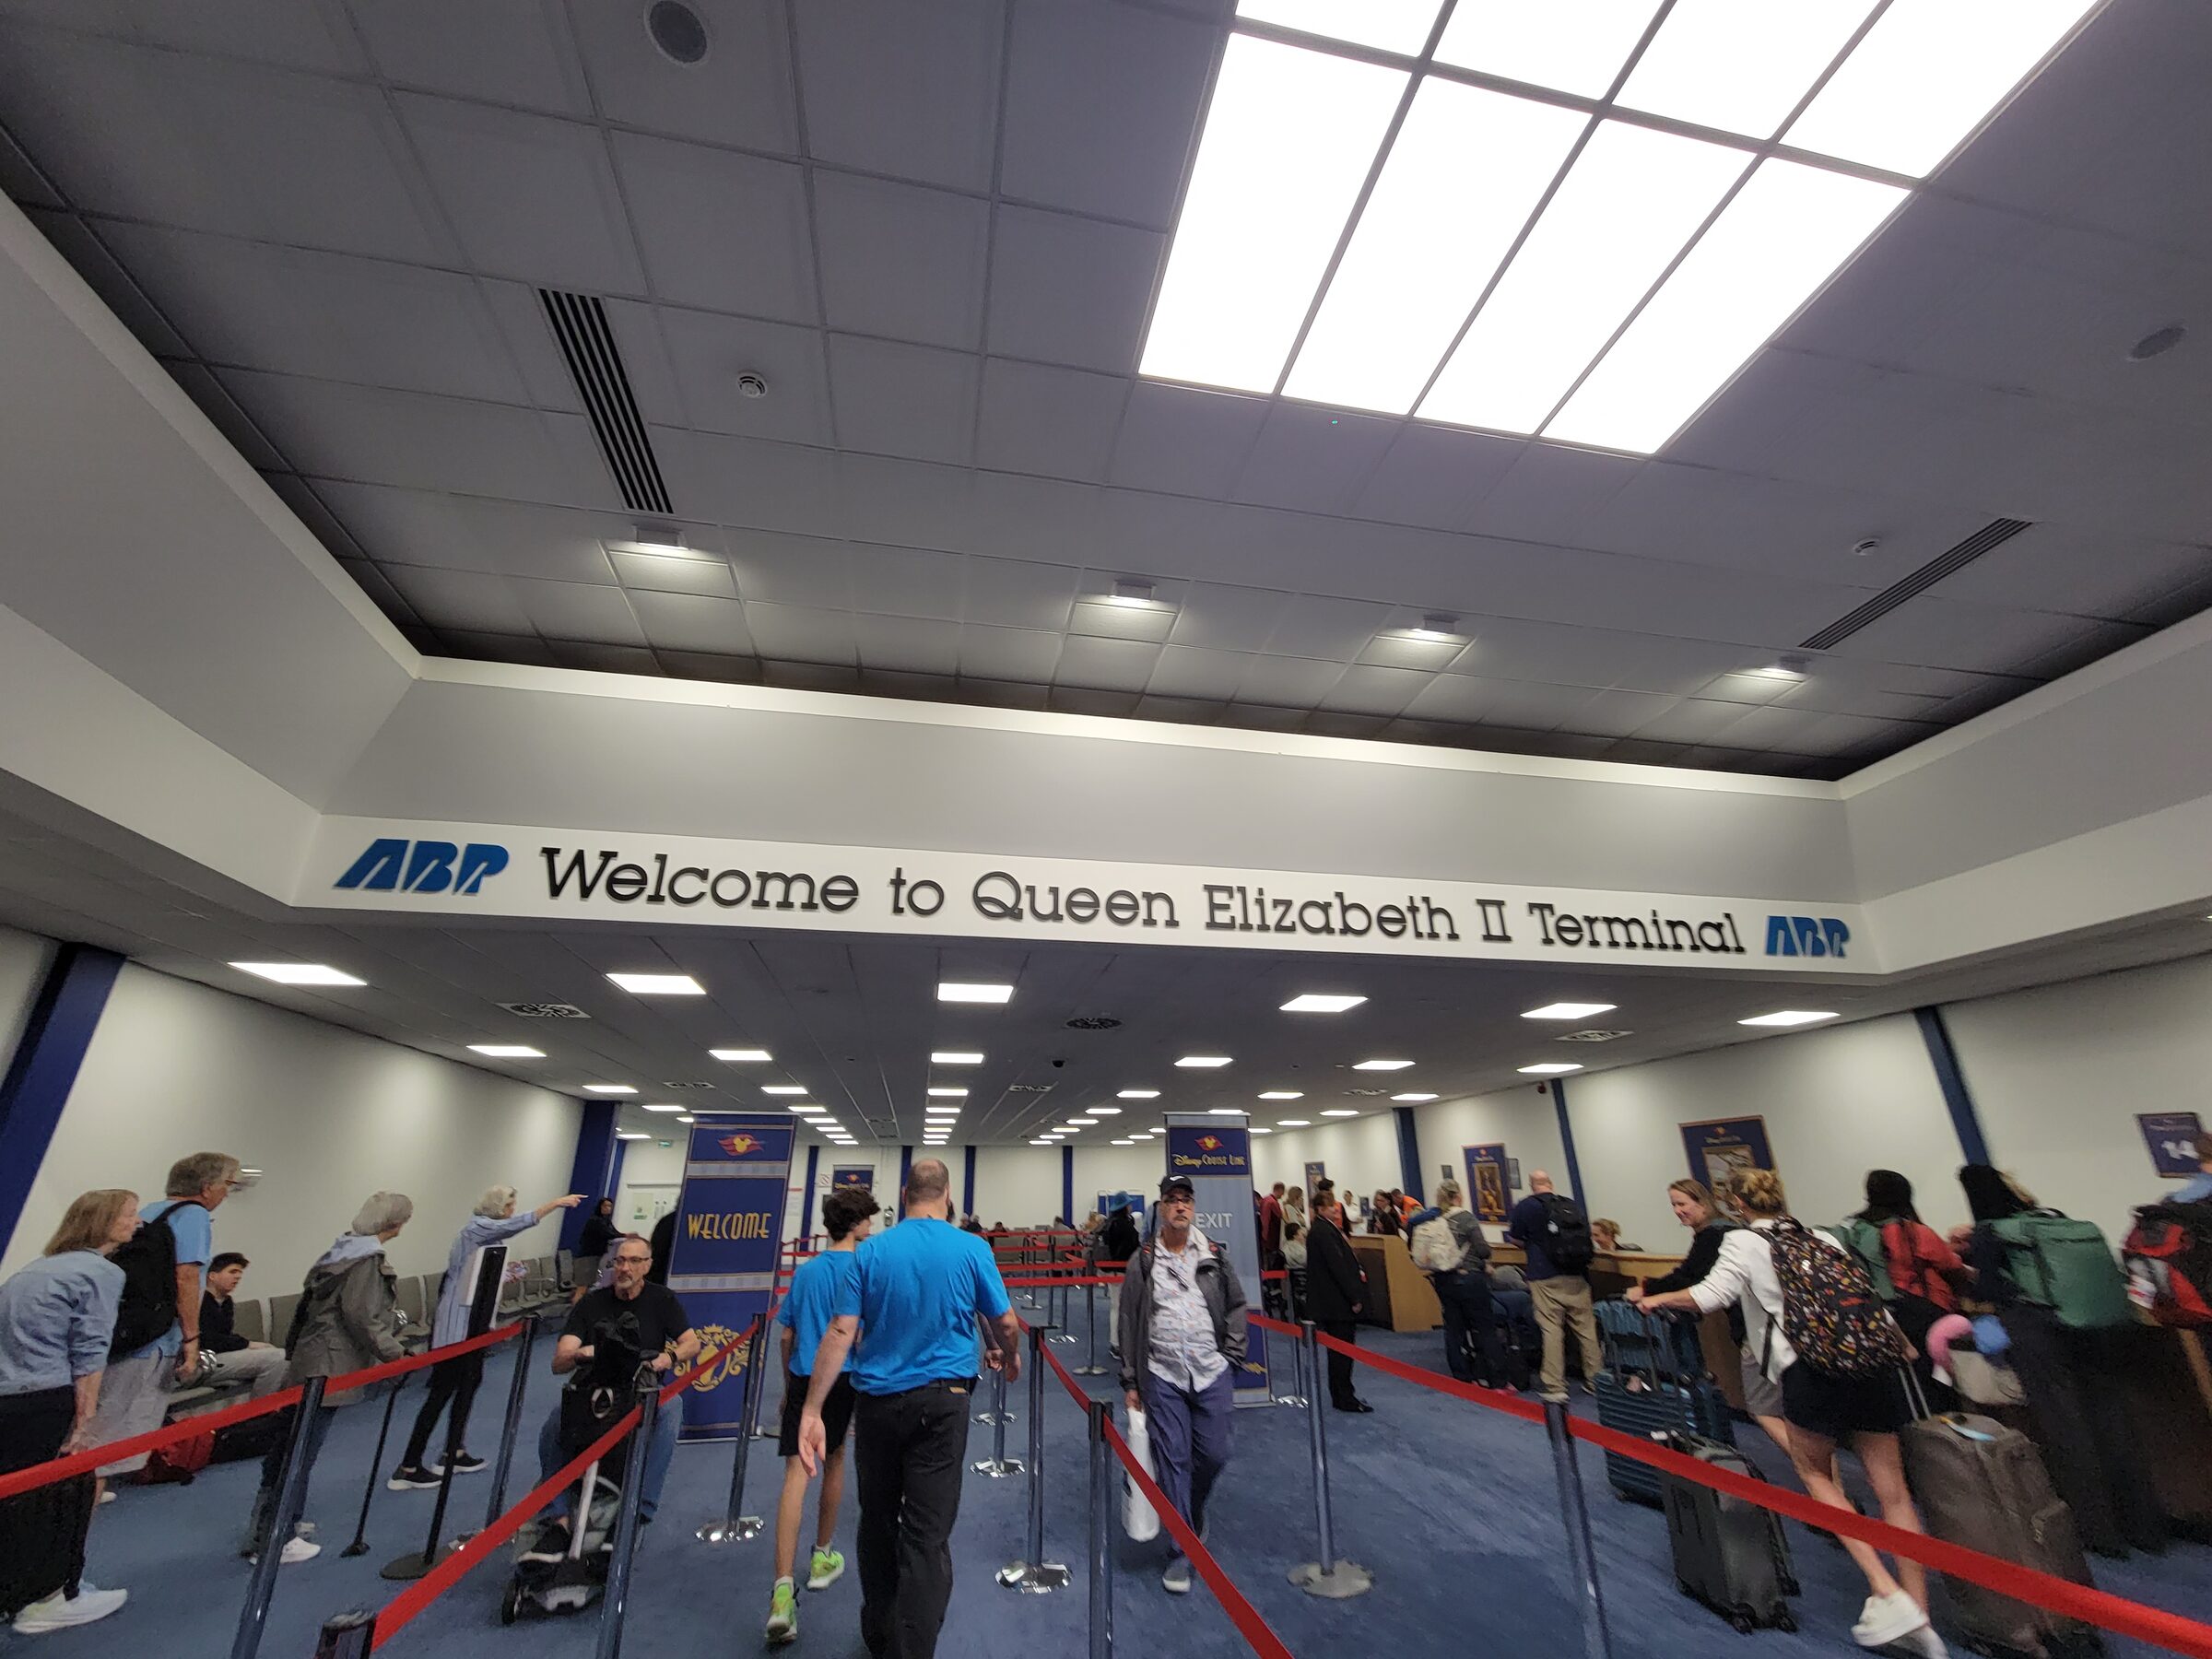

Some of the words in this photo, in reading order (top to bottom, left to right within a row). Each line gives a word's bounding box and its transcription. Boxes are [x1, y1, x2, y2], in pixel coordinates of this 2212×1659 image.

[333, 838, 509, 895] ABP
[540, 846, 858, 912] Welcome
[890, 866, 944, 916] to
[973, 871, 1179, 927] Queen
[1204, 884, 1459, 941] Elizabeth
[1477, 898, 1512, 944] II
[1527, 901, 1747, 955] Terminal
[1765, 915, 1851, 959] ABP
[1172, 1153, 1202, 1168] Disney
[687, 1212, 772, 1240] WELCOME
[1194, 1212, 1233, 1229] EXIT
